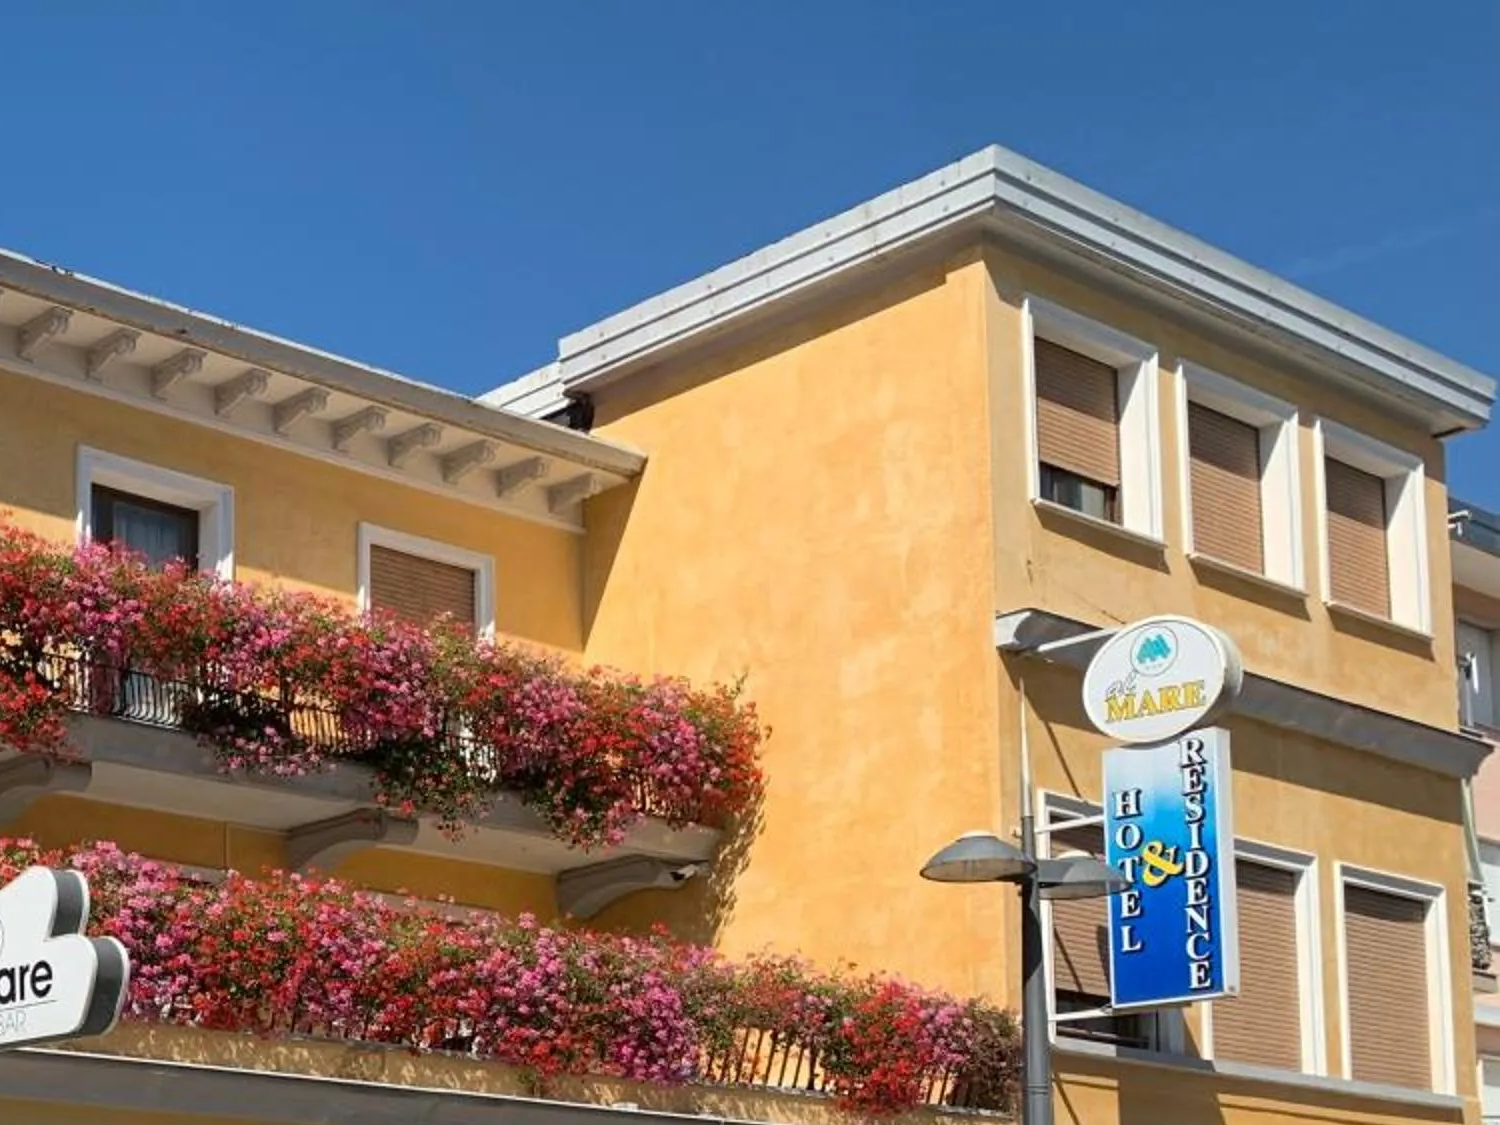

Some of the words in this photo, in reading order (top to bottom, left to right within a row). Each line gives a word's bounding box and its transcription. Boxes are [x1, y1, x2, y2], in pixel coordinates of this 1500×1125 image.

[1104, 679, 1207, 724] MARE
[1112, 787, 1144, 953] HOTEL
[1142, 841, 1184, 887] &
[1178, 737, 1212, 991] RESIDENCE
